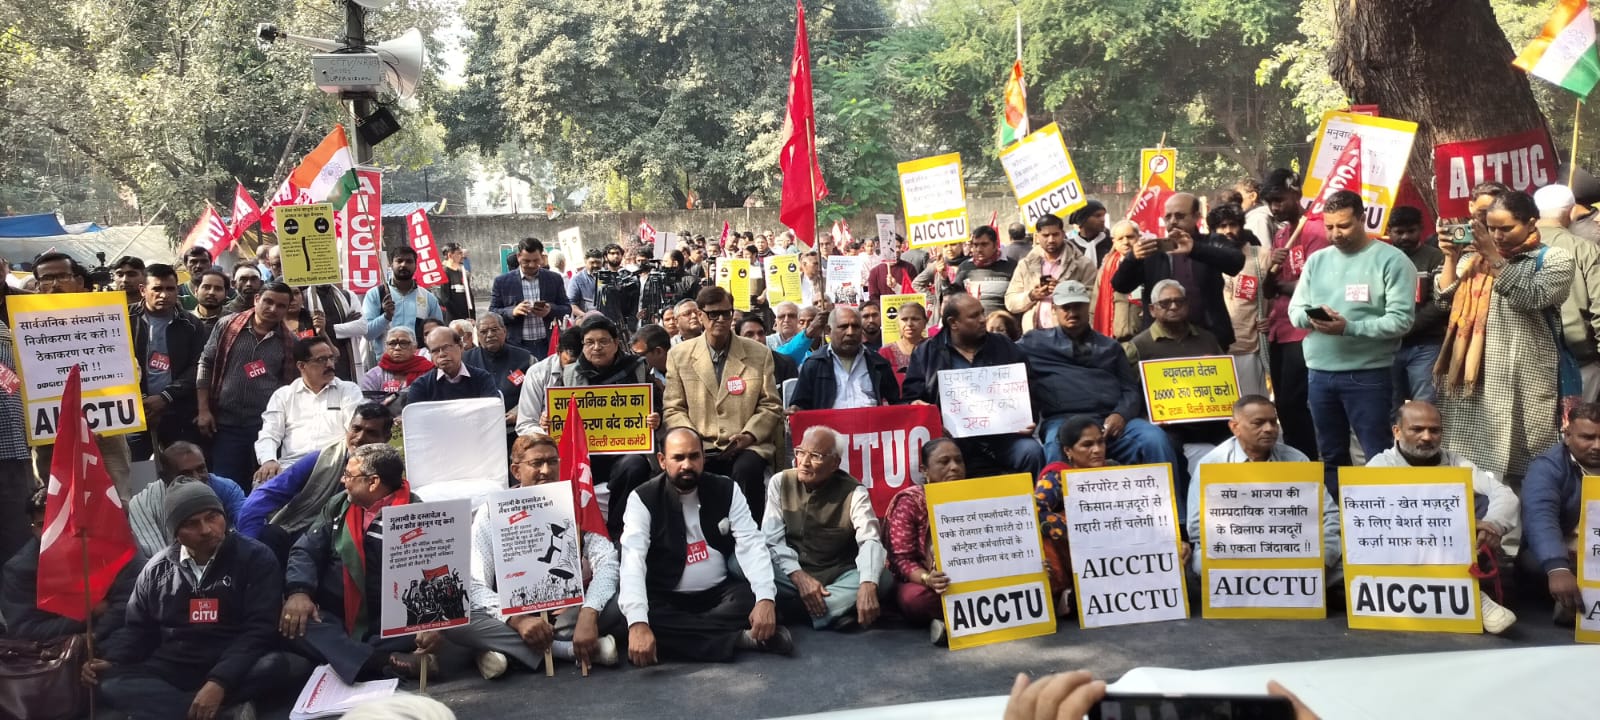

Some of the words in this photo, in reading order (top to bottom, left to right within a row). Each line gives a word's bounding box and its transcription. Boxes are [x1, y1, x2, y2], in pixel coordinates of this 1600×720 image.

[1449, 144, 1548, 199] AITUC
[1027, 182, 1078, 222] AICCTU
[351, 176, 378, 288] AICCTU
[914, 218, 965, 242] AICCTU
[411, 212, 442, 284] AIUTUC
[19, 316, 68, 331] सार्वजनिक
[71, 313, 105, 325] संस्थानों
[108, 313, 121, 321] का
[24, 333, 71, 347] निजीकरण
[74, 331, 87, 341] बंद
[89, 328, 108, 339] करो
[112, 328, 121, 337] !!
[83, 348, 94, 356] पर
[97, 344, 115, 354] रोक
[92, 361, 101, 371] !!
[151, 360, 170, 371] CITU
[249, 367, 266, 378] CITU
[1162, 366, 1195, 384] न्यूनतम
[1197, 362, 1217, 376] वेतन
[610, 390, 627, 407] क्षेत्र
[630, 394, 644, 407] का
[1153, 389, 1175, 400] 26000
[1192, 385, 1215, 402] लागू
[34, 398, 136, 436] AICTU
[606, 413, 621, 430] बंद
[589, 435, 608, 446] दिल्ली
[610, 438, 625, 446] राज्य
[627, 434, 646, 446] कमेटी
[838, 426, 931, 489] ITUC
[1077, 480, 1119, 494] कॉरपोरेट
[1122, 477, 1132, 491] से
[1134, 475, 1160, 489] यारी,
[1221, 488, 1238, 499] संघ
[1251, 489, 1282, 499] भाजपा
[1286, 487, 1300, 499] की
[1079, 495, 1150, 513] किसान-मज़दूरों
[1152, 494, 1162, 507] से
[1210, 505, 1264, 517] साम्प्रदायिक
[1268, 505, 1308, 517] राजनीति
[1344, 496, 1385, 510] किसानों
[1398, 496, 1418, 509] खेत
[1421, 495, 1460, 512] मज़दूरों
[941, 513, 965, 525] फिक्स्ड
[967, 512, 977, 521] टर्म
[1074, 519, 1101, 535] गद्दारी
[1104, 517, 1122, 531] नहीं
[1124, 515, 1154, 529] चलेगी
[1159, 515, 1168, 527] !!
[1353, 516, 1364, 528] के
[1368, 516, 1392, 530] लिए
[1396, 515, 1422, 528] बेशर्त
[1426, 517, 1451, 527] सारा
[939, 529, 957, 539] पक्के
[959, 526, 982, 537] रोजगार
[984, 525, 994, 534] की
[995, 521, 1014, 532] गारंटी
[1016, 521, 1024, 530] दो
[1026, 521, 1034, 529] !!
[1216, 524, 1226, 536] के
[1230, 523, 1264, 536] खिलाफ
[1268, 522, 1302, 539] मजदूरों
[979, 537, 1014, 549] कर्मचारियों
[1015, 535, 1023, 544] के
[1213, 542, 1226, 554] की
[1230, 543, 1256, 554] एकता
[1260, 540, 1301, 553] जिंदाबाद
[1388, 536, 1412, 547] माफ़
[1416, 535, 1437, 547] करो
[1443, 536, 1453, 547] !!
[687, 550, 707, 563] CITU
[947, 556, 974, 568] अधिकार
[976, 555, 997, 565] छीनना
[1000, 553, 1010, 561] बंद
[1011, 551, 1024, 559] करो
[1027, 550, 1034, 558] !!
[1082, 552, 1174, 579] AICCTU
[1214, 576, 1318, 596] AICCTU
[1086, 588, 1179, 615] AICCTU
[1356, 582, 1470, 616] AICCTU
[192, 610, 217, 620] CITU
[953, 588, 1044, 631] AICCTU
